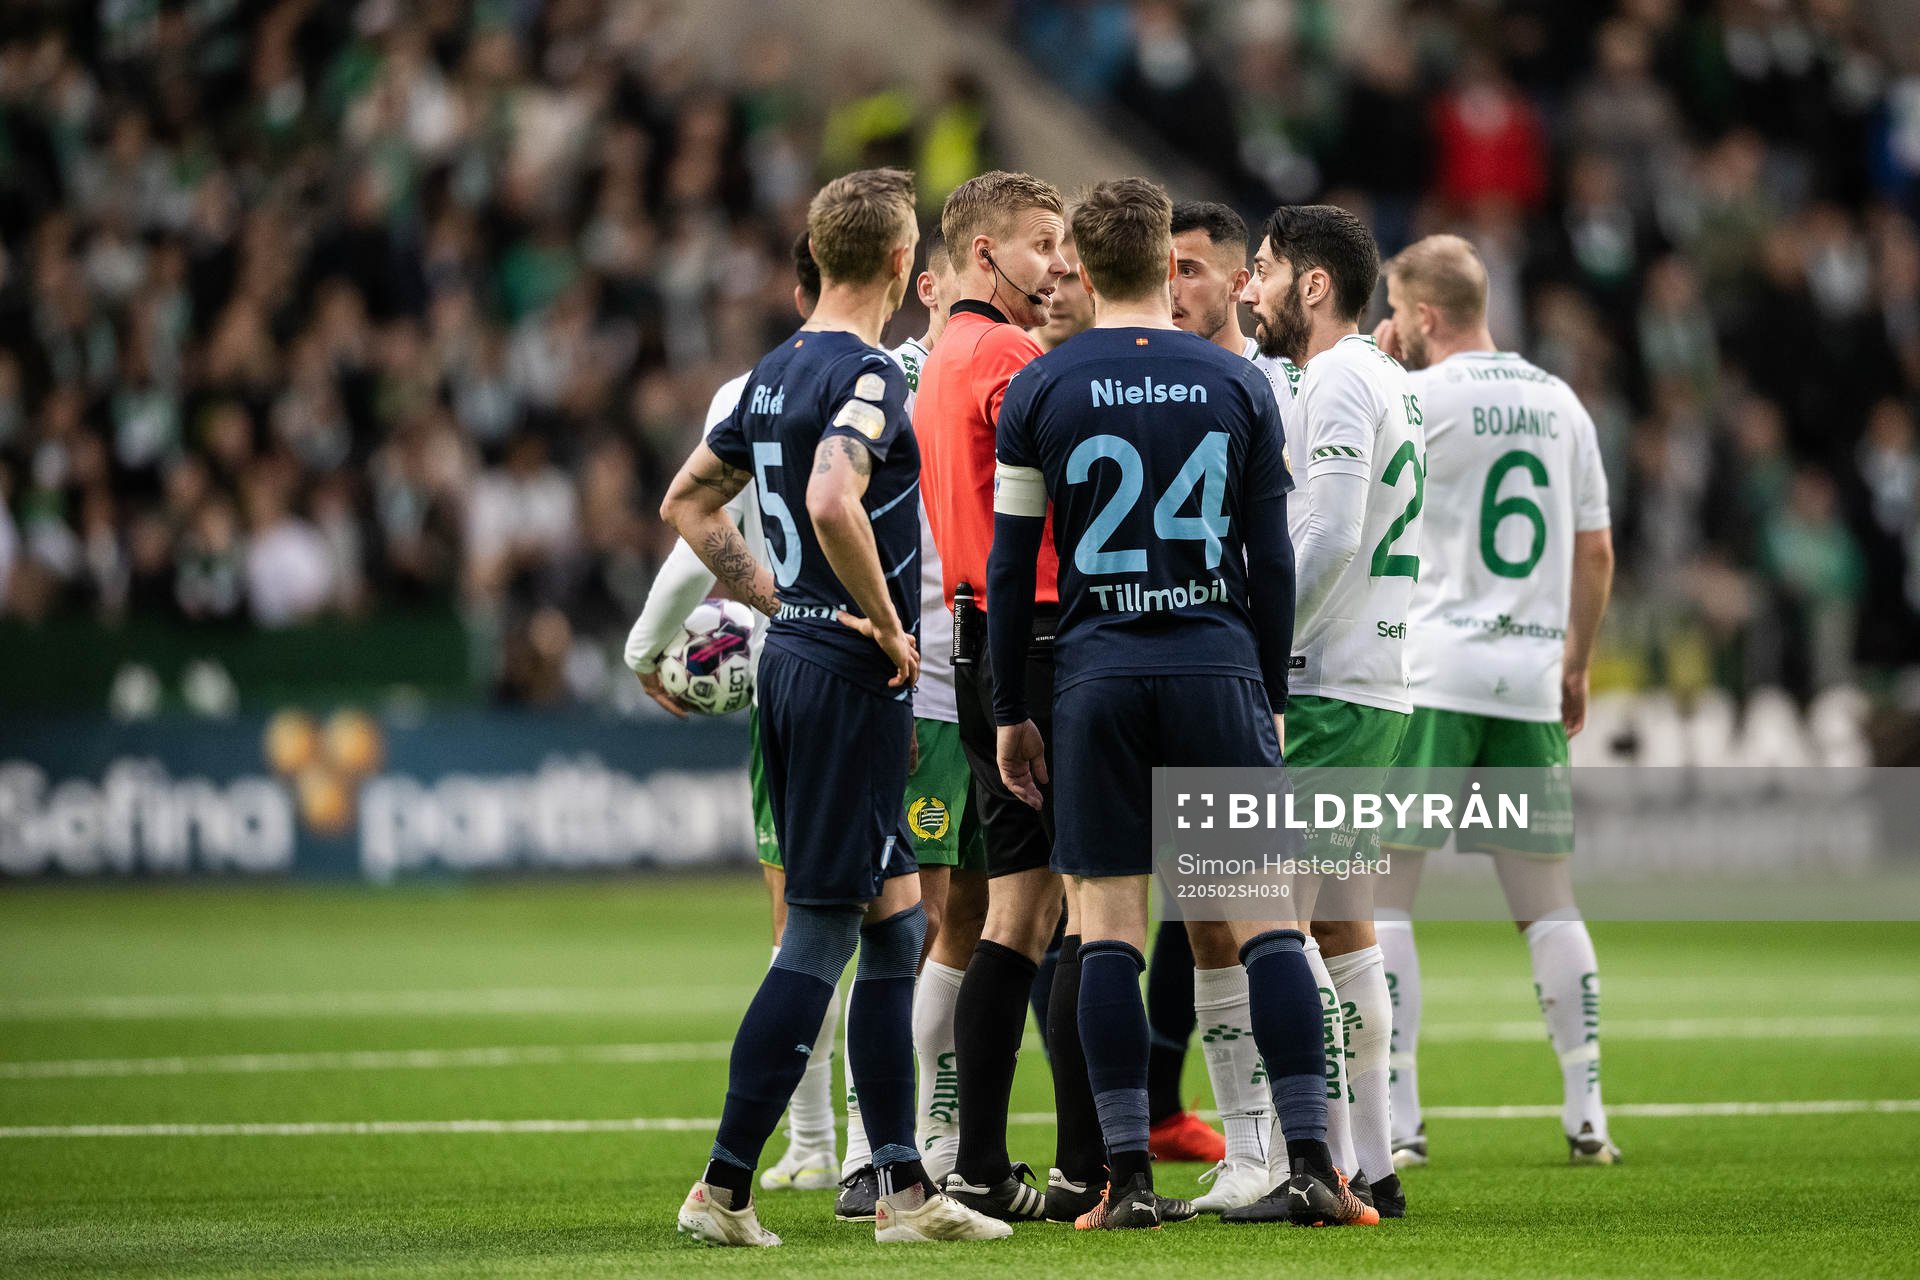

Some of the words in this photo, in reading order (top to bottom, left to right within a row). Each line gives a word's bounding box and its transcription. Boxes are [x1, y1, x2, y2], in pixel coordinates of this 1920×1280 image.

[1090, 377, 1207, 408] Nielsen
[1472, 406, 1559, 439] BOJANIC
[752, 442, 802, 588] 5
[1066, 431, 1231, 575] 24
[1370, 440, 1427, 584] 2
[1479, 450, 1549, 578] 6
[954, 603, 963, 623] SPRAY
[1090, 578, 1229, 612] Tillmobil
[953, 624, 961, 657] VANISHING
[1318, 987, 1343, 1100] Clinton
